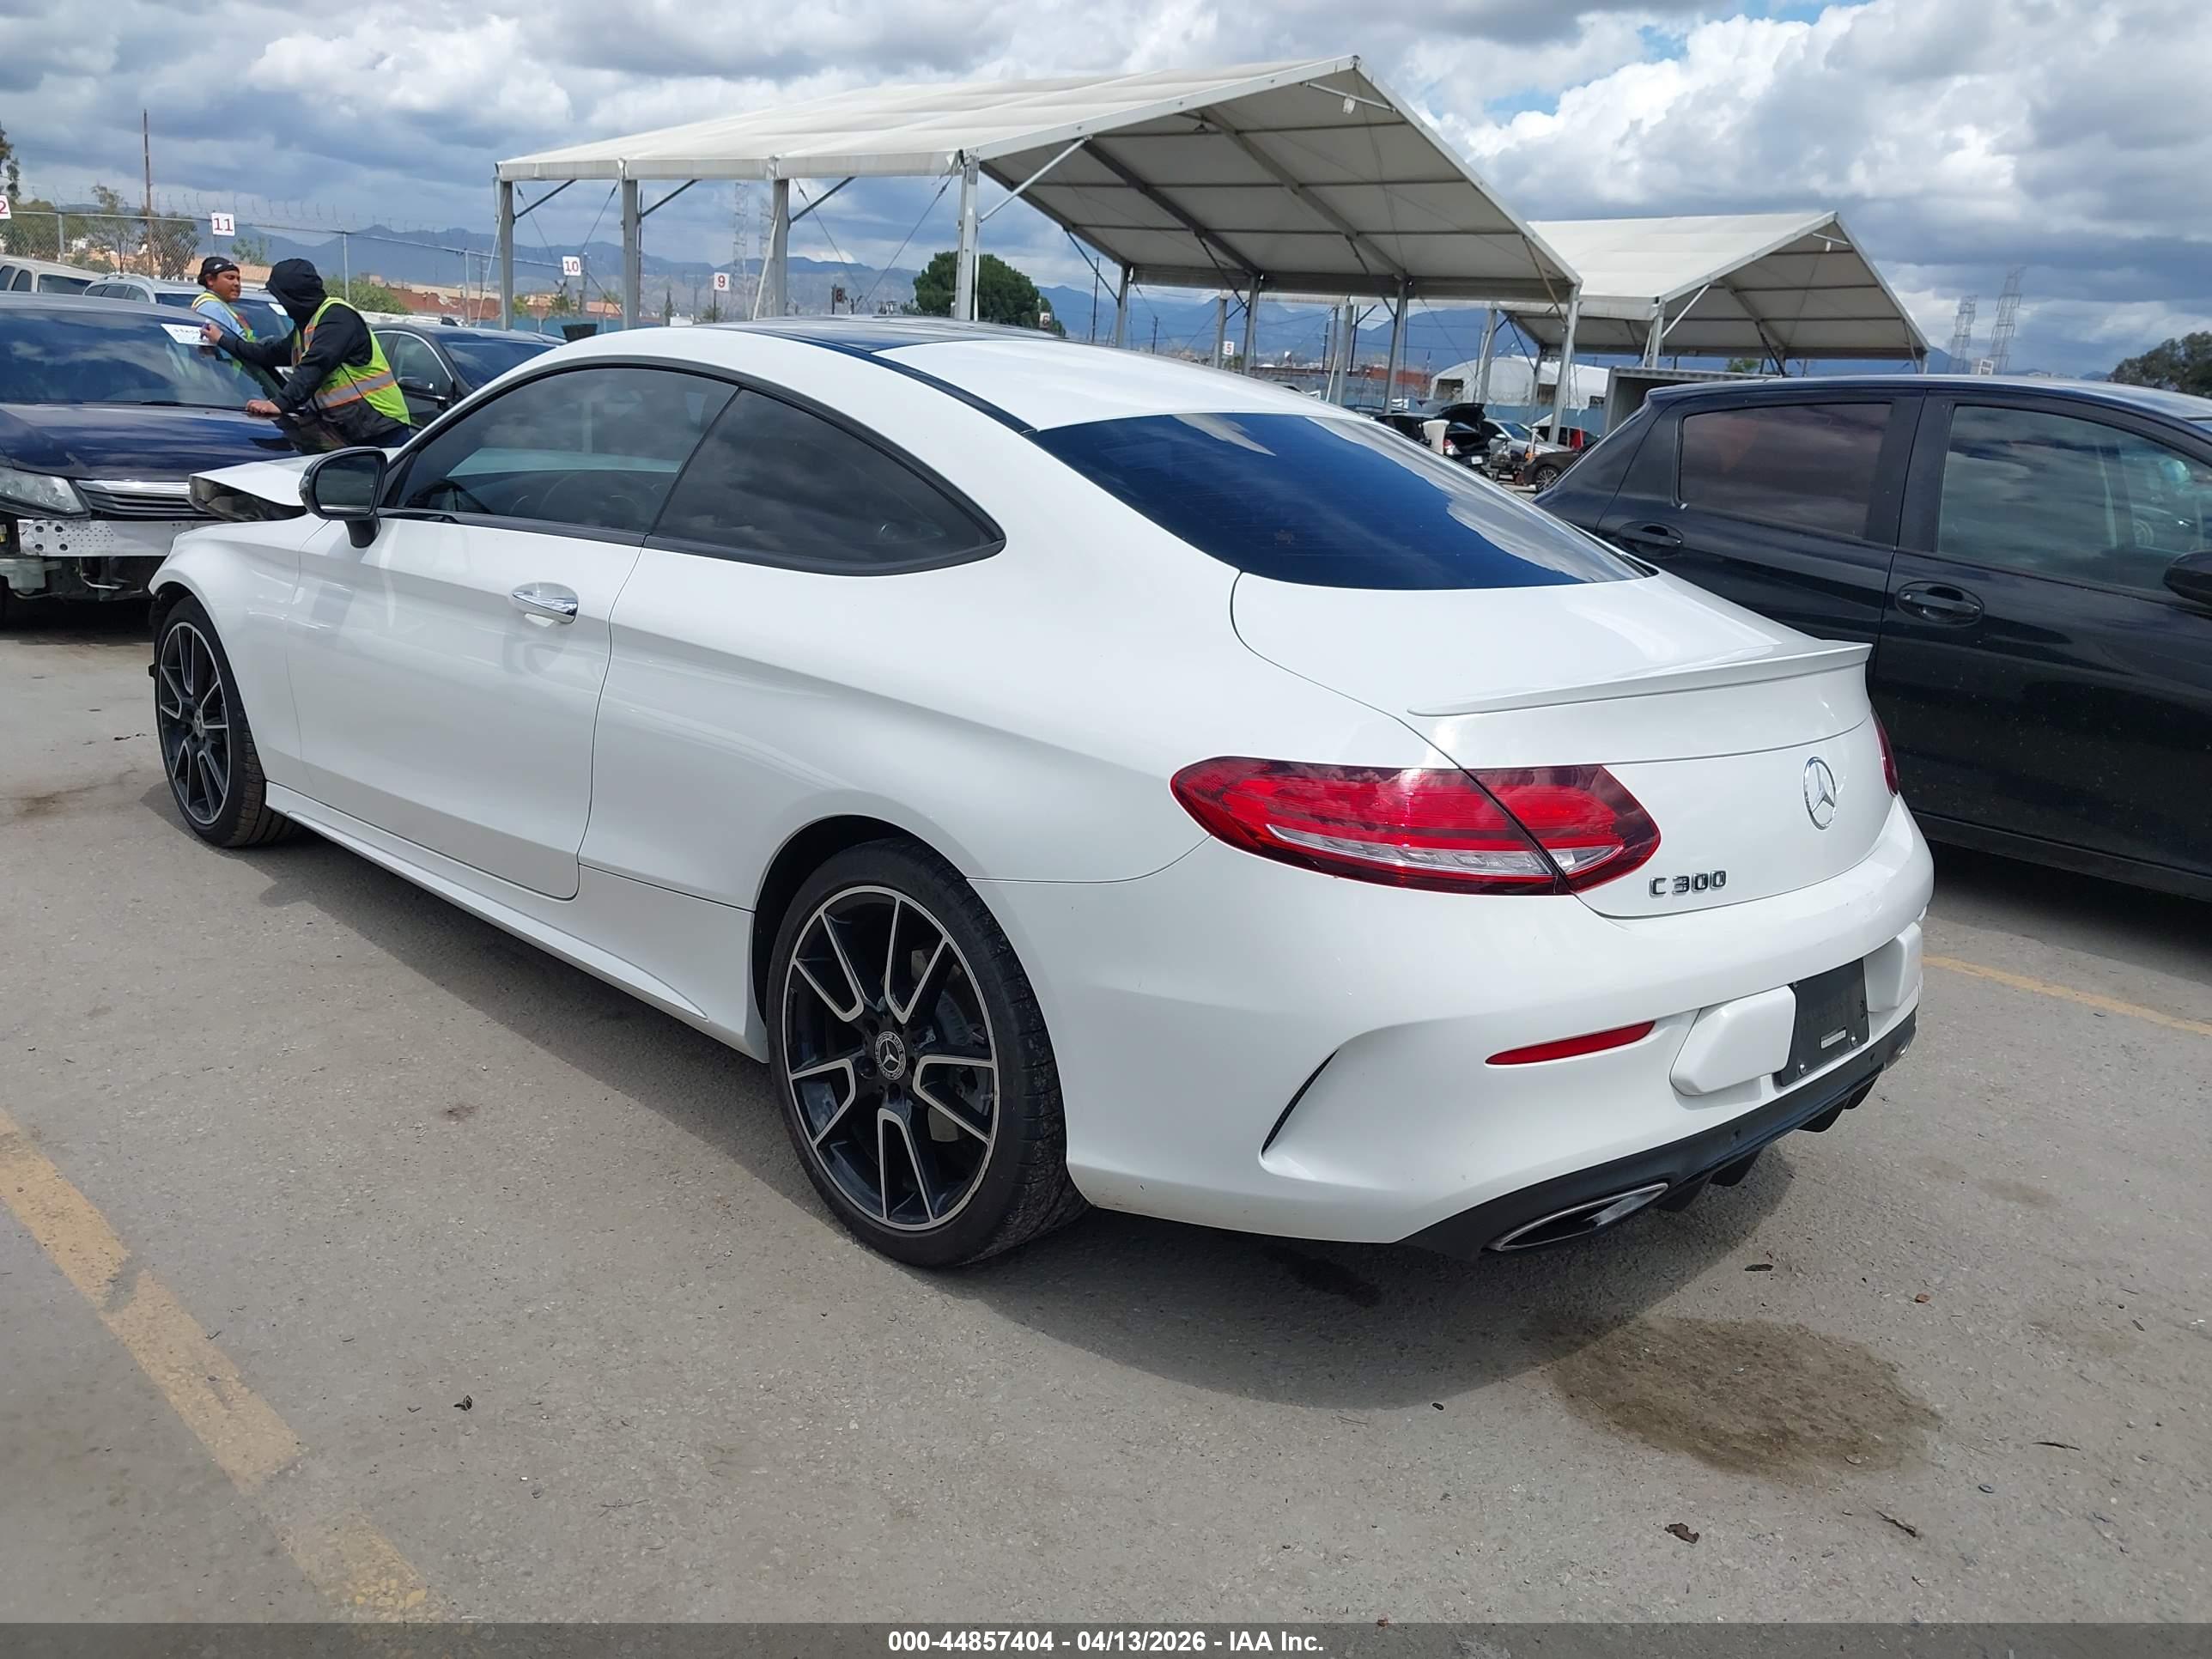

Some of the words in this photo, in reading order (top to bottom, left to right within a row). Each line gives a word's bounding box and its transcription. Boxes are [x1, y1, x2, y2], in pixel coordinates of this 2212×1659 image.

[214, 217, 234, 232] 11
[565, 261, 579, 272] 10
[718, 275, 726, 289] 9
[1226, 343, 1231, 353] 5
[1649, 878, 1667, 896] C
[1671, 870, 1727, 896] 300
